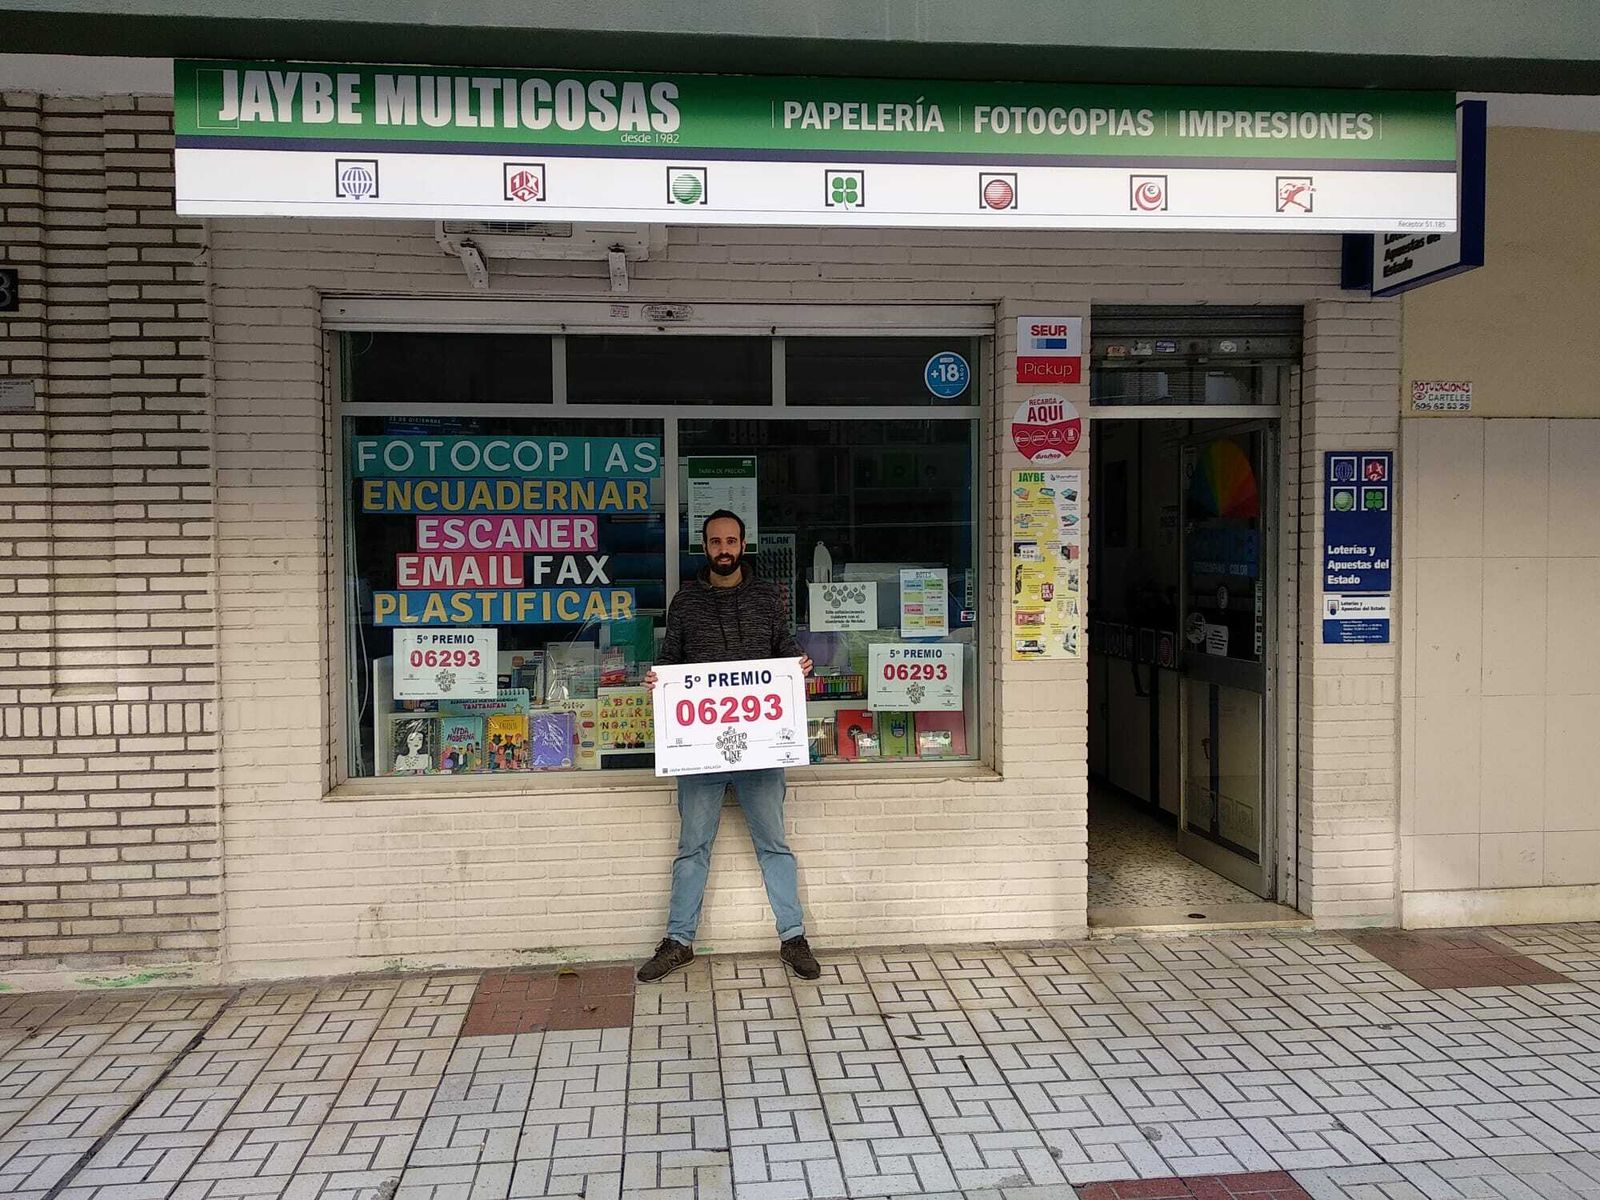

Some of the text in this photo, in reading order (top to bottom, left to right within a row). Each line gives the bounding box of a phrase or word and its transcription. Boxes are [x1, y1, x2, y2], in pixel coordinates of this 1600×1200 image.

[218, 69, 681, 133] JAYBE MULTICOSAS
[783, 96, 945, 133] PAPELERÍA
[974, 105, 1154, 137] FOTOCOPIAS
[1179, 109, 1374, 140] IMPRESIONES
[621, 132, 680, 144] desde 1982
[1425, 220, 1446, 228] 51.185
[1031, 325, 1067, 336] SEUR
[1024, 362, 1073, 376] Pickup
[1027, 400, 1064, 423] AQUÍ
[357, 441, 657, 472] FOTOCOPIAS
[1018, 472, 1045, 482] JAYBE
[362, 480, 649, 511] ENCUADERNAR
[417, 518, 596, 549] ESCANER
[1328, 545, 1375, 556] Loterías y
[398, 555, 610, 586] EMAIL FAX
[1328, 560, 1389, 571] Apuestas del
[1328, 575, 1360, 584] Estado
[373, 590, 633, 624] PLASTIFICAR
[432, 634, 475, 644] PREMIO
[410, 650, 481, 667] 06293
[903, 649, 942, 658] PREMIO
[708, 670, 772, 687] PREMIO
[883, 663, 947, 680] 06293
[676, 694, 783, 726] 06293
